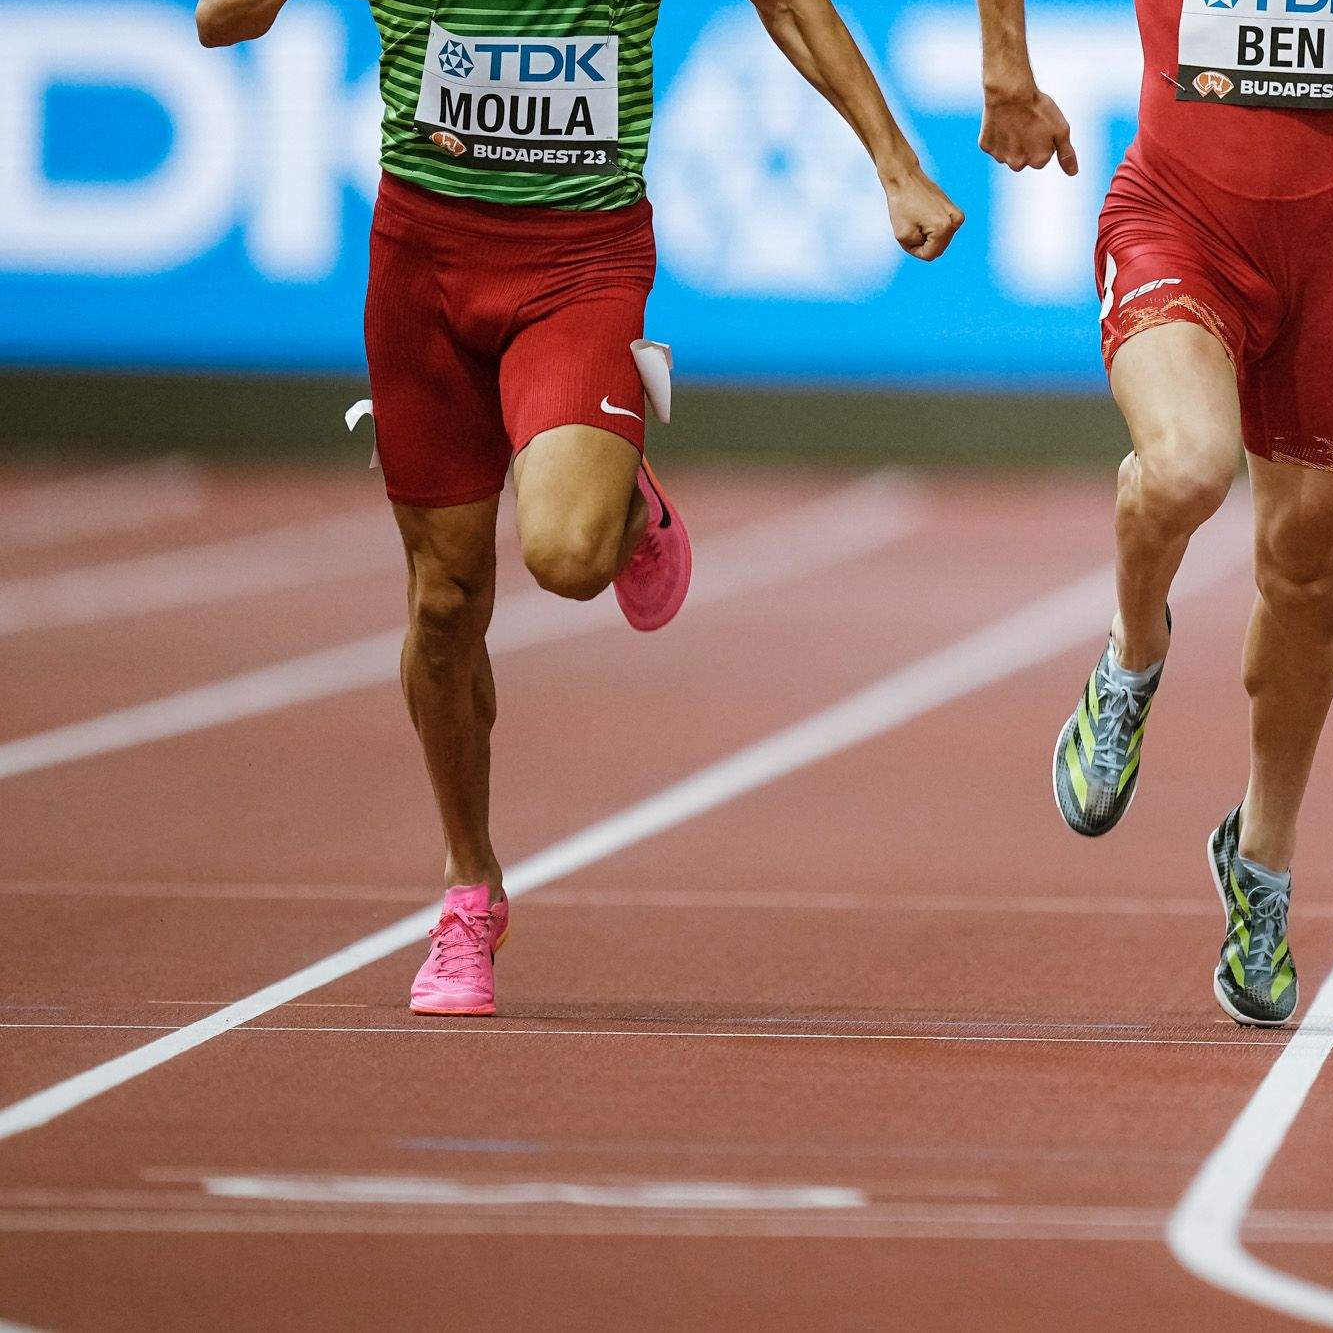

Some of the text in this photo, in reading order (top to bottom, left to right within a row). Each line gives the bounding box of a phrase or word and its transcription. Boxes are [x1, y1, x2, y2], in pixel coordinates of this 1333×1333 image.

[474, 43, 606, 83] TDK
[1237, 24, 1325, 70] BEN
[439, 86, 595, 136] MOULA
[473, 143, 607, 165] BUDAPEST 23
